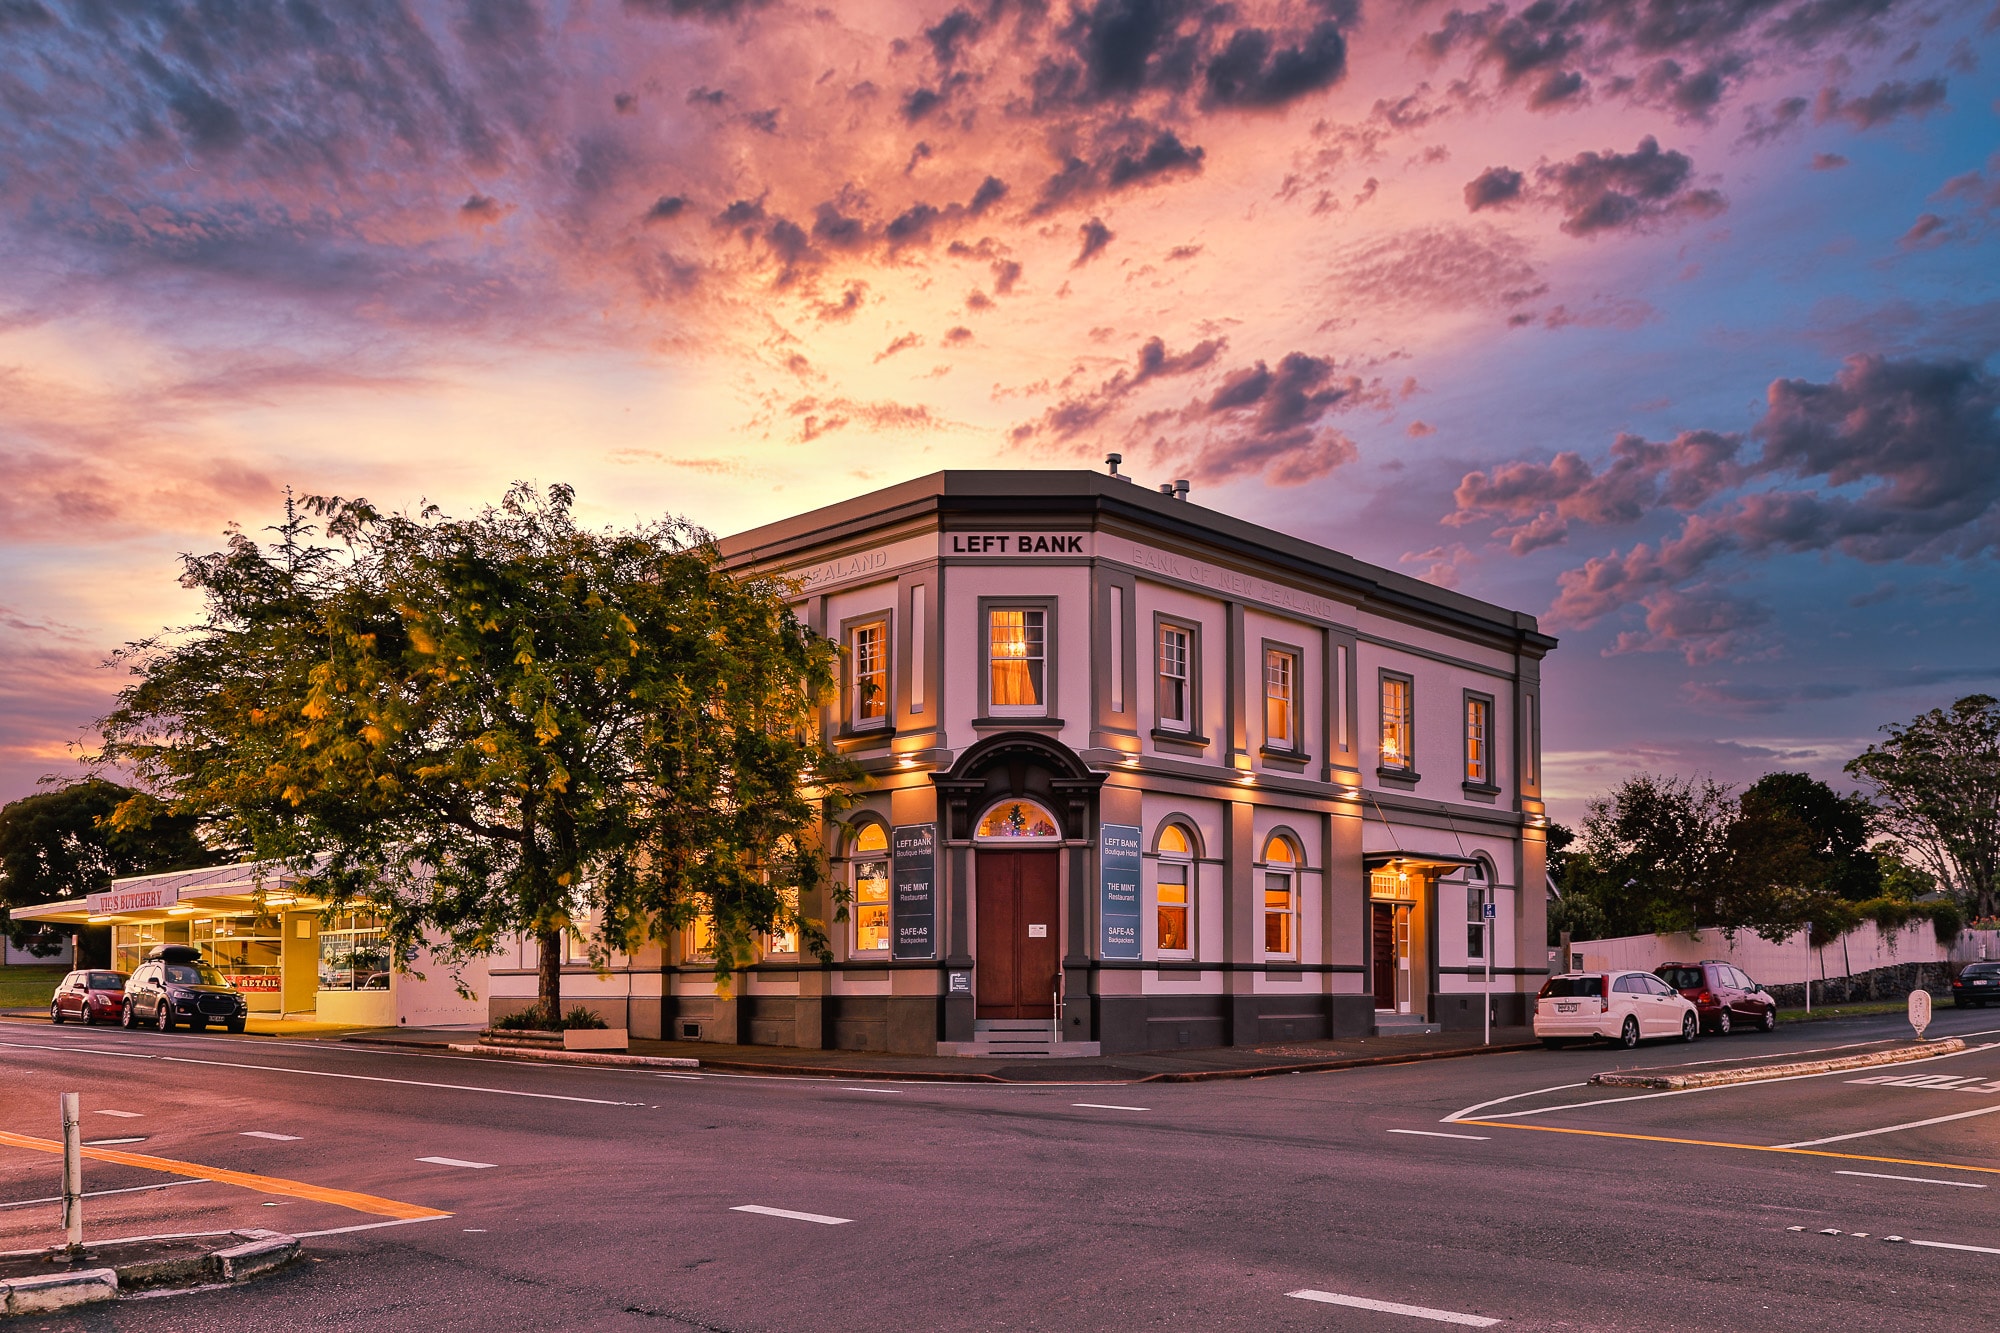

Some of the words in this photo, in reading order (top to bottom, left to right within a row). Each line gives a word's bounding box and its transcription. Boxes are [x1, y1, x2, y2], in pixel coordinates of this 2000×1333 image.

[954, 536, 1009, 553] LEFT
[1018, 536, 1083, 553] BANK
[1132, 546, 1181, 576] BANK
[1189, 566, 1210, 583] OF
[1218, 571, 1253, 596] NEW
[1261, 584, 1334, 618] ZEALAND
[896, 839, 911, 848] LEFT
[913, 837, 931, 847] BANK
[1104, 837, 1120, 846] LEFT
[1121, 839, 1138, 848] BANK
[918, 848, 932, 856] Hotel
[1104, 848, 1125, 857] Boutique
[1125, 849, 1138, 857] Hotel
[899, 883, 912, 892] THE
[913, 882, 929, 891] MINT
[1107, 882, 1120, 891] THE
[1120, 883, 1136, 892] MINT
[100, 895, 119, 912] VIC'S
[120, 890, 162, 910] BUTCHERY
[900, 893, 928, 901] Restaurant
[1108, 892, 1135, 901] Restaurant
[900, 927, 928, 936] SAFE-AS
[1108, 926, 1135, 936] SAFE-AS
[900, 937, 928, 945] Backpackers
[1108, 936, 1135, 944] Backpackers
[241, 979, 278, 988] RETAIL
